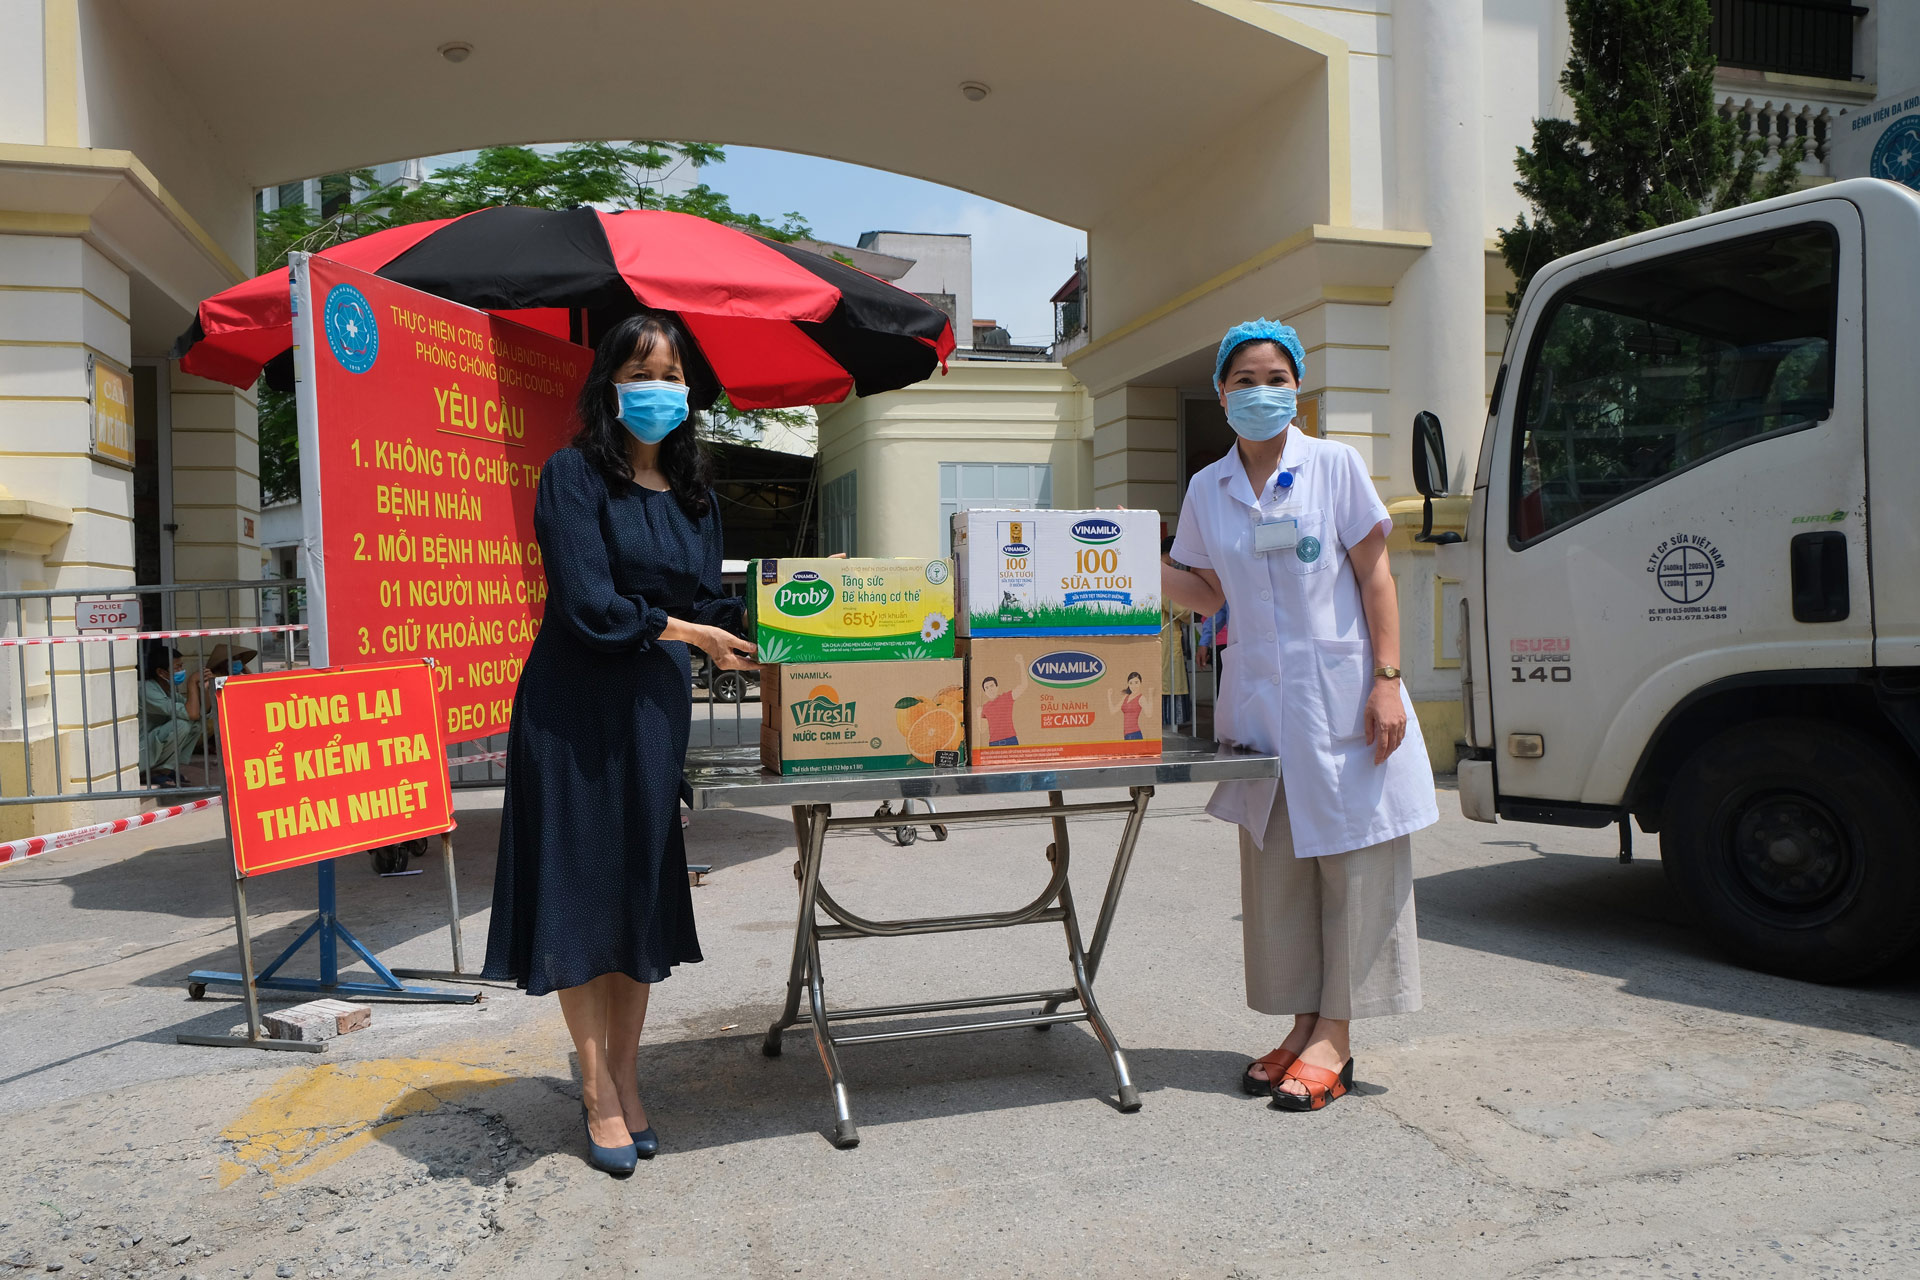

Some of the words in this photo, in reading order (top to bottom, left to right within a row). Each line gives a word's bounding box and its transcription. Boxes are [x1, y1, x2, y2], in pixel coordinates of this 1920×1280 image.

[1904, 96, 1920, 110] KHO
[390, 306, 426, 334] THỰC
[429, 318, 455, 343] HIỆN
[458, 328, 484, 351] CT05
[488, 335, 510, 361] CỦA
[416, 342, 457, 369] PHÒNG
[459, 354, 497, 380] CHỐNG
[499, 366, 523, 388] DỊCH
[524, 373, 564, 398] COVID-19
[434, 383, 477, 430] YÊU
[484, 396, 525, 439] CẦU
[351, 438, 369, 468] 1.
[375, 438, 443, 476] KHÔNG
[448, 448, 470, 480] TỔ
[475, 455, 519, 487] CHỨC
[377, 486, 429, 522] BỆNH
[435, 488, 482, 521] NHÂN
[1074, 525, 1118, 535] VINAMILK
[354, 532, 372, 560] 2.
[378, 529, 417, 562] MỖI
[423, 532, 473, 569] BỆNH
[478, 535, 523, 565] NHÂN
[1646, 553, 1659, 573] C.TY
[1657, 542, 1668, 554] CP
[1670, 533, 1688, 545] SỮA
[1692, 535, 1711, 549] VIỆT
[1709, 547, 1725, 569] NAM
[380, 580, 402, 608] 01
[409, 574, 472, 606] NGƯỜI
[478, 574, 512, 605] NHÀ
[842, 575, 863, 589] Tăng
[867, 575, 884, 586] sức
[1061, 575, 1090, 590] SỮA
[1094, 575, 1132, 588] TƯƠI
[781, 587, 829, 607] Proby
[858, 590, 887, 605] kháng
[890, 592, 901, 602] cơ
[904, 588, 921, 602] thể
[89, 613, 128, 624] STOP
[358, 627, 376, 655] 3.
[382, 618, 421, 653] GIỮ
[427, 616, 503, 650] KHOẢNG
[1511, 638, 1570, 651] ISUZU
[469, 653, 523, 688] NGƯỜI
[1036, 661, 1099, 675] VINAMILK
[1512, 667, 1571, 682] 140
[265, 694, 350, 733] DỪNG
[358, 688, 402, 724] LẠI
[448, 704, 486, 733] ĐEO
[795, 702, 852, 724] Vfresh
[1041, 702, 1059, 712] ĐẬU
[1062, 701, 1088, 710] NÀNH
[1054, 714, 1088, 725] CANXI
[793, 730, 817, 741] NƯỚC
[820, 732, 840, 740] CAM
[845, 728, 856, 739] ÉP
[244, 742, 286, 790] ĐỂ
[294, 734, 371, 782] KIỂM
[378, 733, 431, 767] TRA
[257, 797, 340, 842] THÂN
[347, 778, 429, 823] NHIỆT
